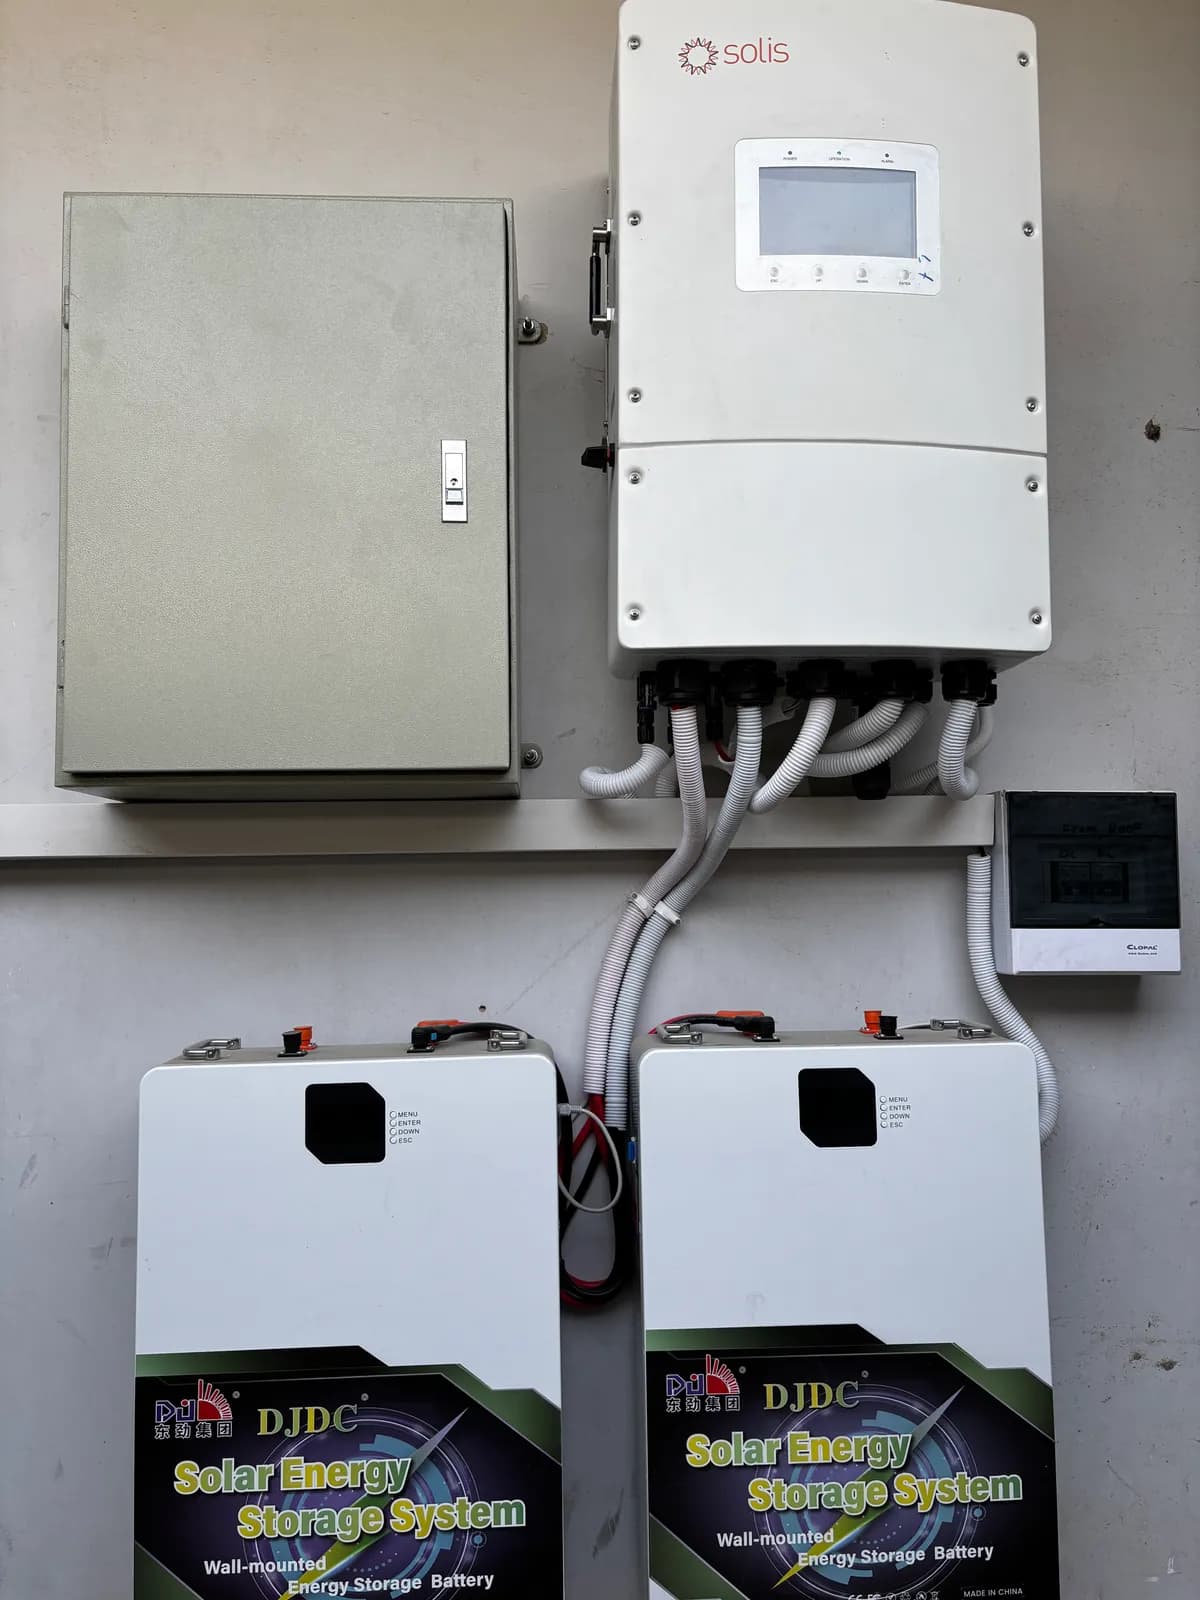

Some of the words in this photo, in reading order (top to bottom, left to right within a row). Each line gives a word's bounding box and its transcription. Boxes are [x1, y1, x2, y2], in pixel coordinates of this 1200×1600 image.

[723, 37, 790, 64] solis
[398, 1119, 421, 1127] ENTER
[666, 1396, 741, 1413] 东劲集团
[763, 1381, 860, 1413] DJDC
[154, 1421, 233, 1439] 东劲集团
[257, 1404, 358, 1438] DJDC
[686, 1432, 783, 1468] Solar
[787, 1431, 914, 1469] Energy
[174, 1458, 274, 1494] Solar
[280, 1455, 412, 1494] Energy
[748, 1478, 889, 1517] Storage
[893, 1472, 1023, 1513] System
[237, 1504, 385, 1543] Storage
[390, 1497, 526, 1540] System
[717, 1529, 835, 1548] Wall-mounted
[204, 1556, 327, 1576] Wall-mounted
[798, 1551, 857, 1569] Energy
[860, 1548, 926, 1566] Storage
[934, 1545, 995, 1563] Battery
[288, 1579, 349, 1597] Energy
[354, 1575, 422, 1595] Storage
[432, 1573, 494, 1591] Battery
[963, 1588, 986, 1598] MADE
[987, 1588, 997, 1597] IN
[998, 1587, 1023, 1597] CHINA
